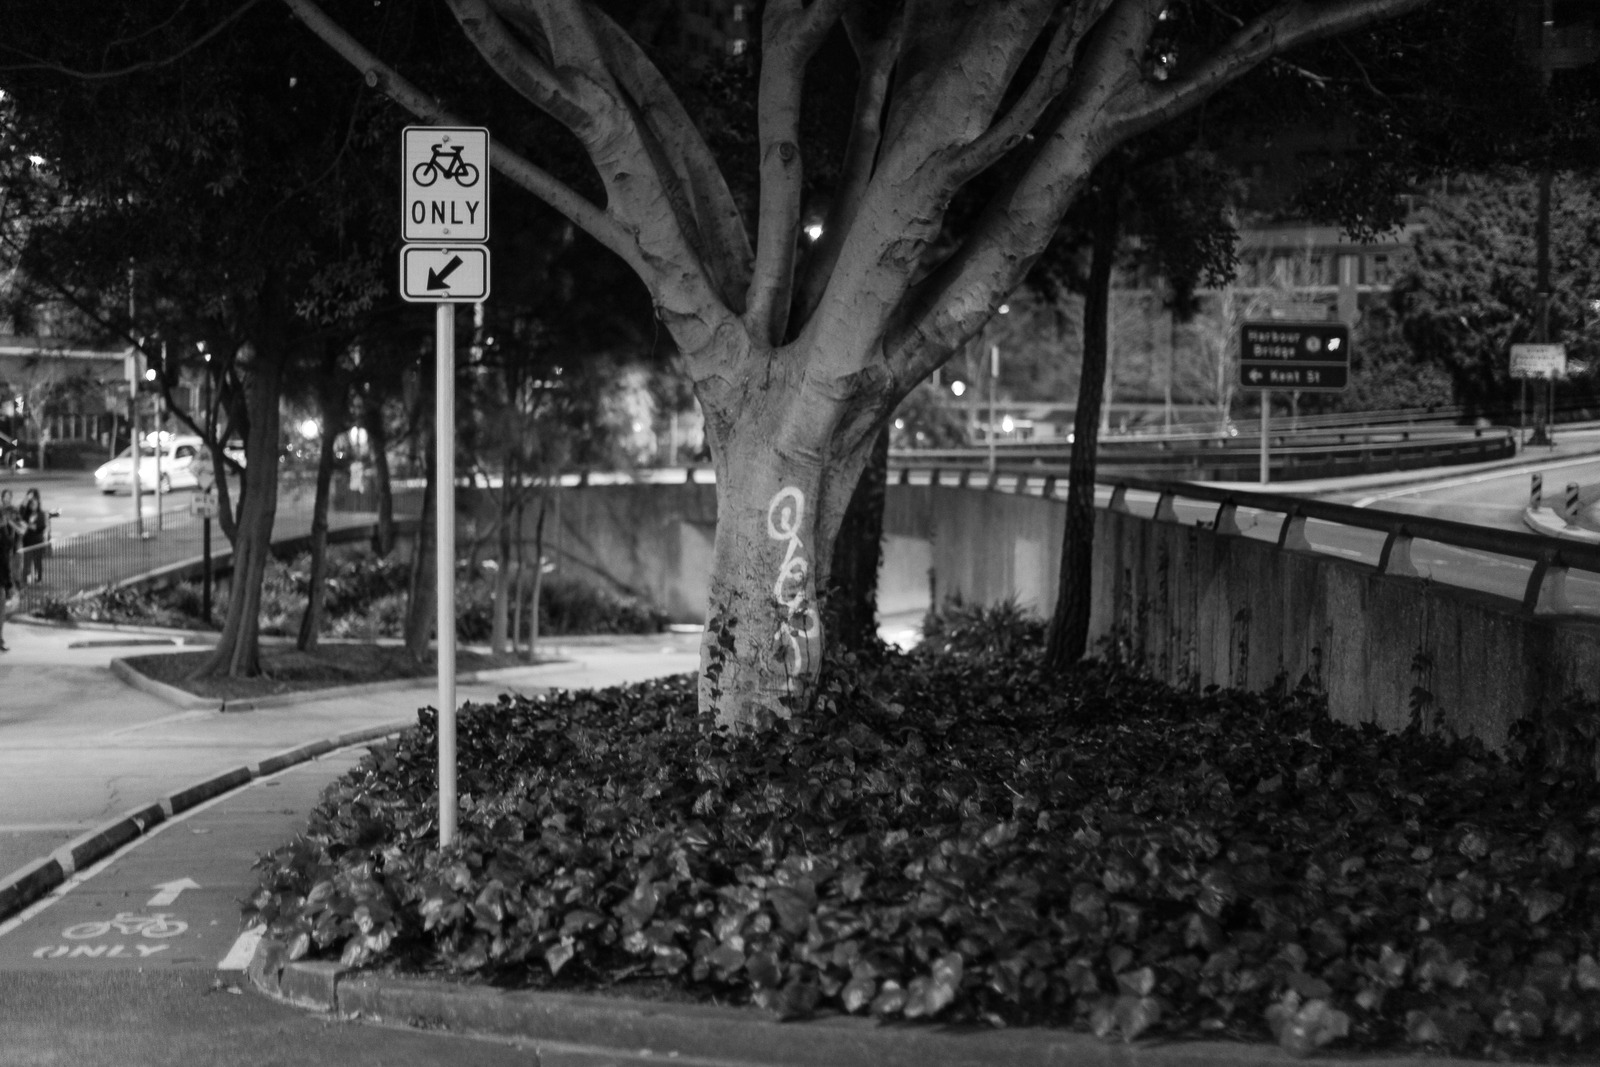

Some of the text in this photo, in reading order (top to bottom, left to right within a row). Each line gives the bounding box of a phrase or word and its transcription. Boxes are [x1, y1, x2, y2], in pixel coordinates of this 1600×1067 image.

[411, 200, 480, 225] ONLY
[1270, 369, 1320, 383] Kent St
[32, 944, 170, 959] ONLY
